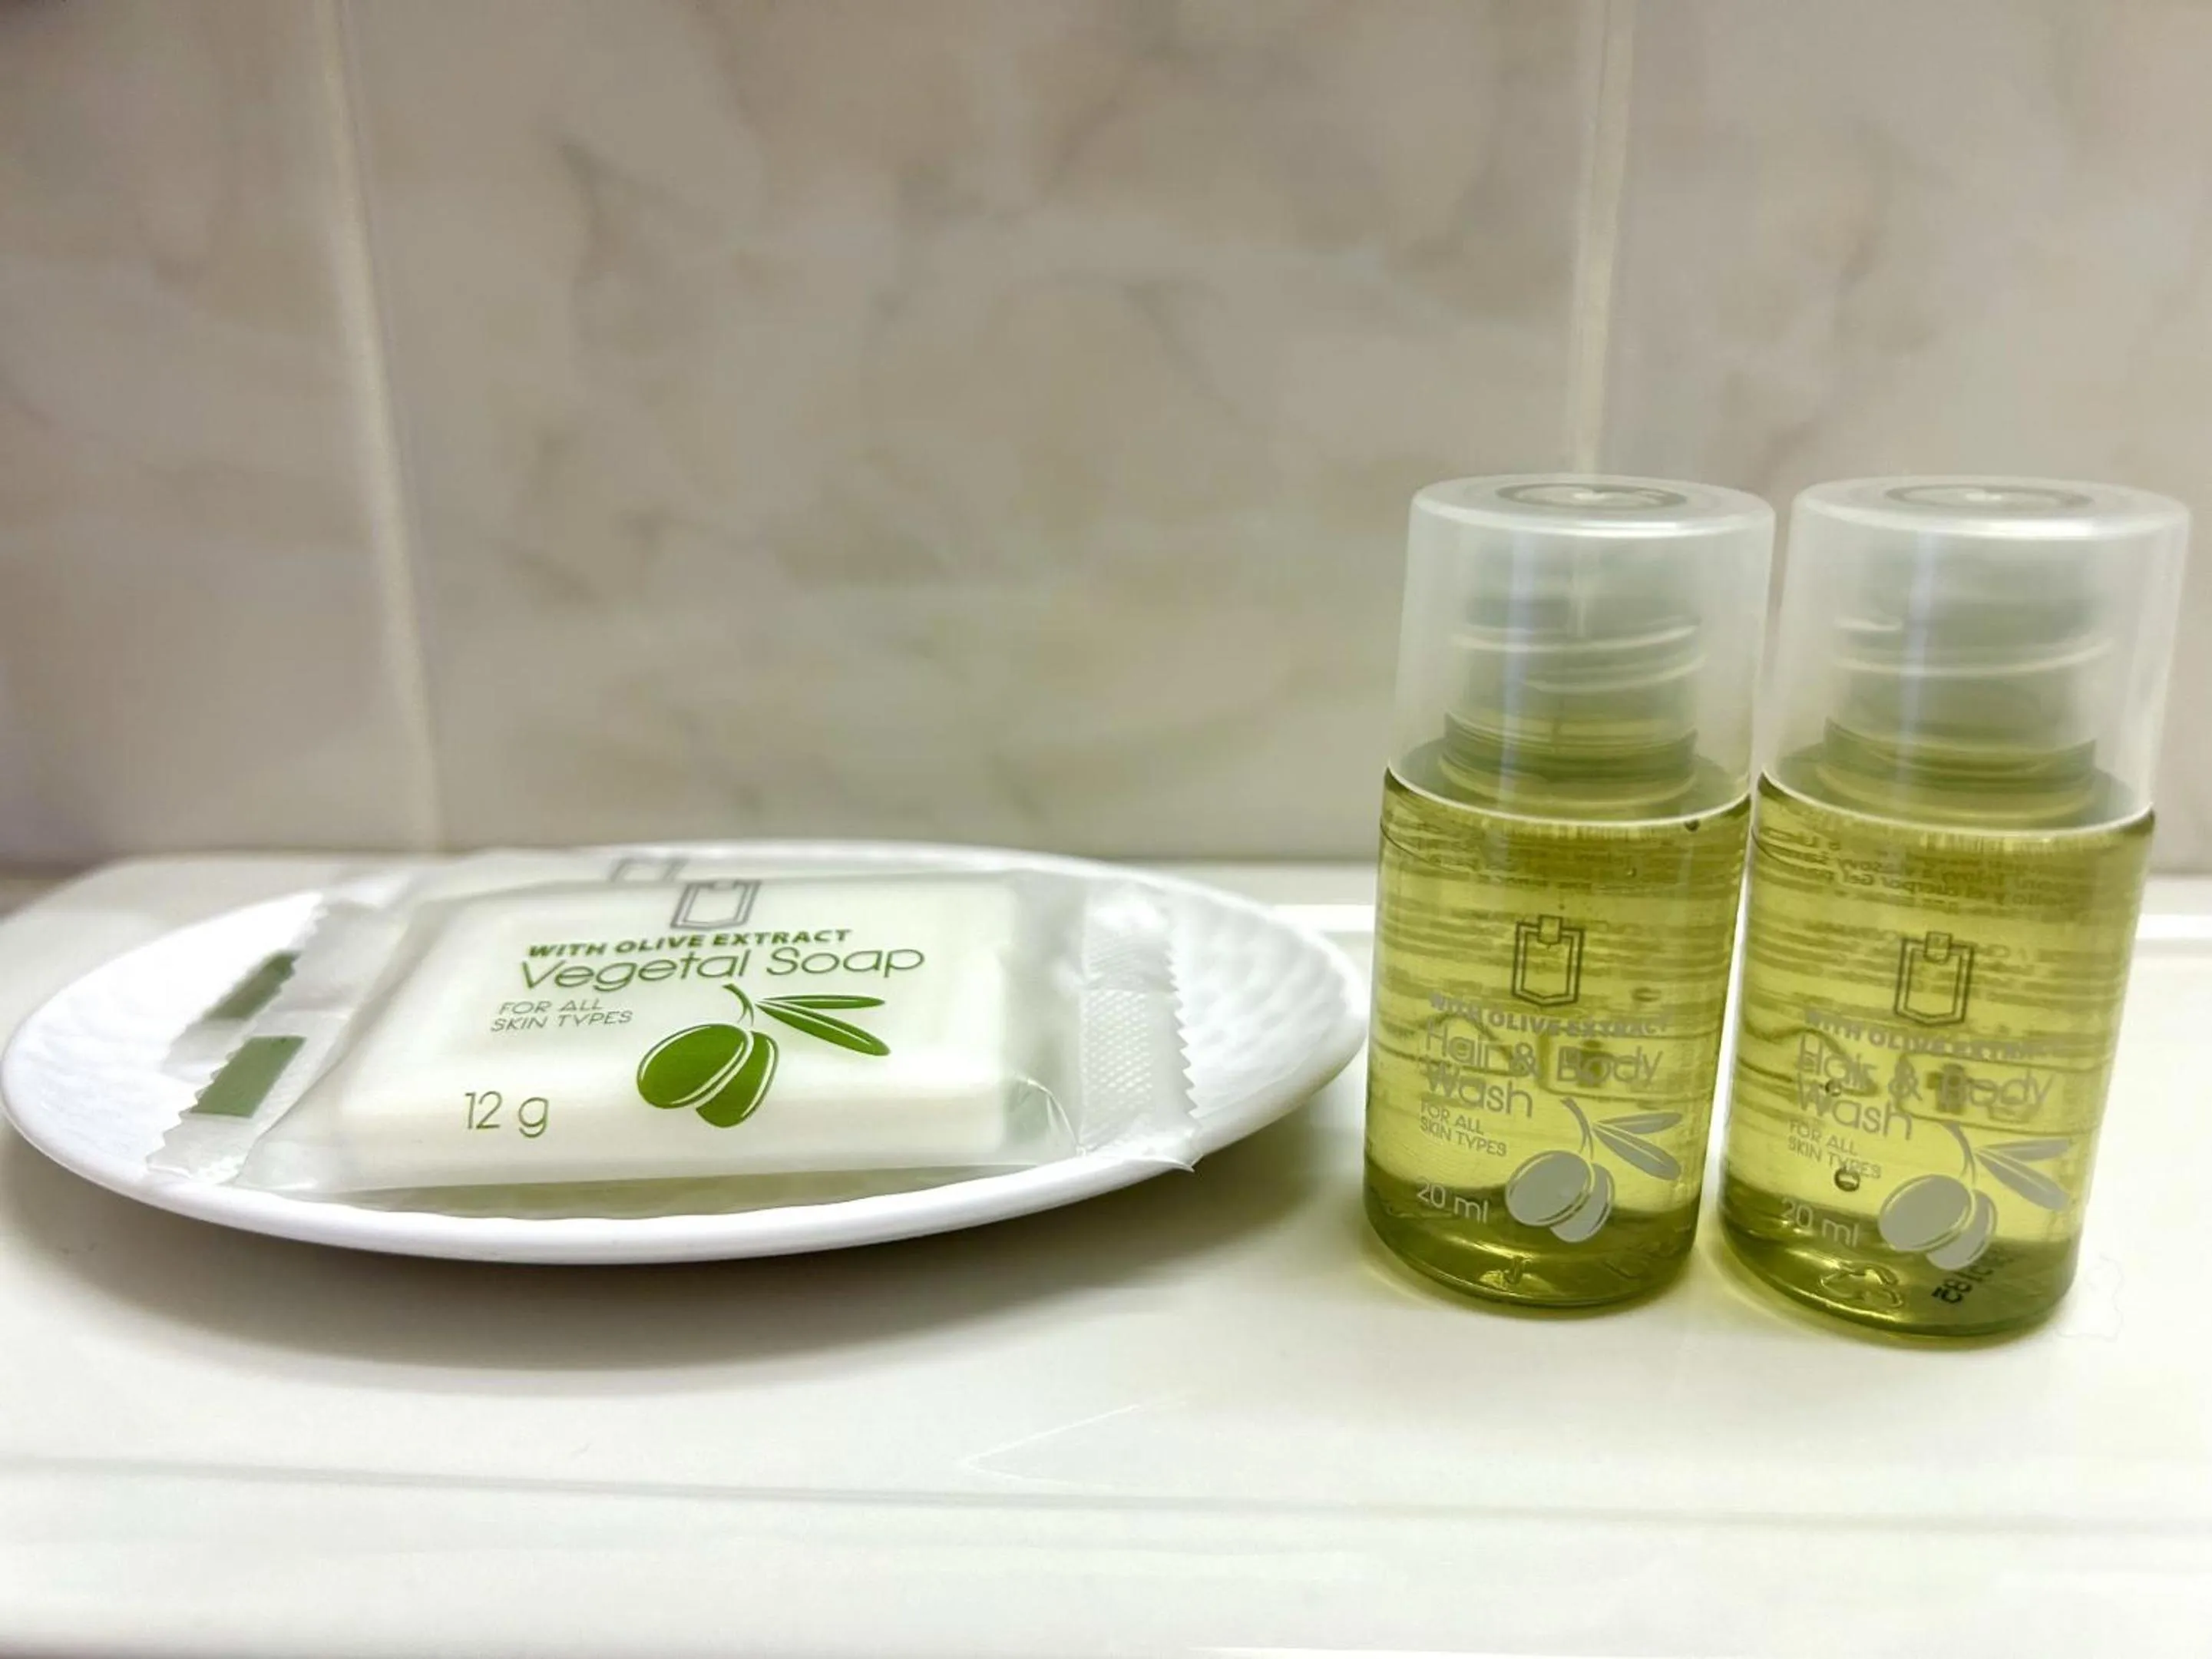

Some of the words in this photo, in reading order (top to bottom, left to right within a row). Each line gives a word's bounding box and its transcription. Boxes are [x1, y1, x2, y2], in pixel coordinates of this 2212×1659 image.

[527, 942, 607, 958] WITH
[614, 933, 706, 953] OLIVE
[713, 929, 852, 947] EXTRACT
[521, 949, 752, 993] Vegetal
[765, 947, 926, 979] Soap
[490, 1016, 548, 1033] SKIN
[557, 1010, 633, 1027] TYPES
[499, 1000, 552, 1015] FOR
[558, 997, 603, 1013] ALL
[1487, 1009, 1562, 1036] OLIVE
[1426, 1016, 1506, 1069] Hair
[1509, 1041, 1538, 1076] &
[1557, 1046, 1664, 1086] Body
[1867, 1026, 1946, 1057] OLIVE
[1423, 1059, 1533, 1119] Wash
[1797, 1073, 1913, 1142] Wash
[465, 1091, 503, 1130] 12
[517, 1096, 549, 1138] g
[1420, 1099, 1451, 1123] FOR
[1454, 1114, 1484, 1136] ALL
[1420, 1115, 1452, 1142] SKIN
[1455, 1130, 1507, 1157] TYPES
[1787, 1135, 1822, 1162] SKIN
[1827, 1152, 1882, 1179] TYPES
[1788, 1119, 1822, 1143] FOR
[1826, 1134, 1858, 1156] ALL
[1417, 1176, 1447, 1209] 20
[1453, 1196, 1490, 1224] ml
[1781, 1196, 1814, 1229] 20
[1821, 1218, 1860, 1249] ml
